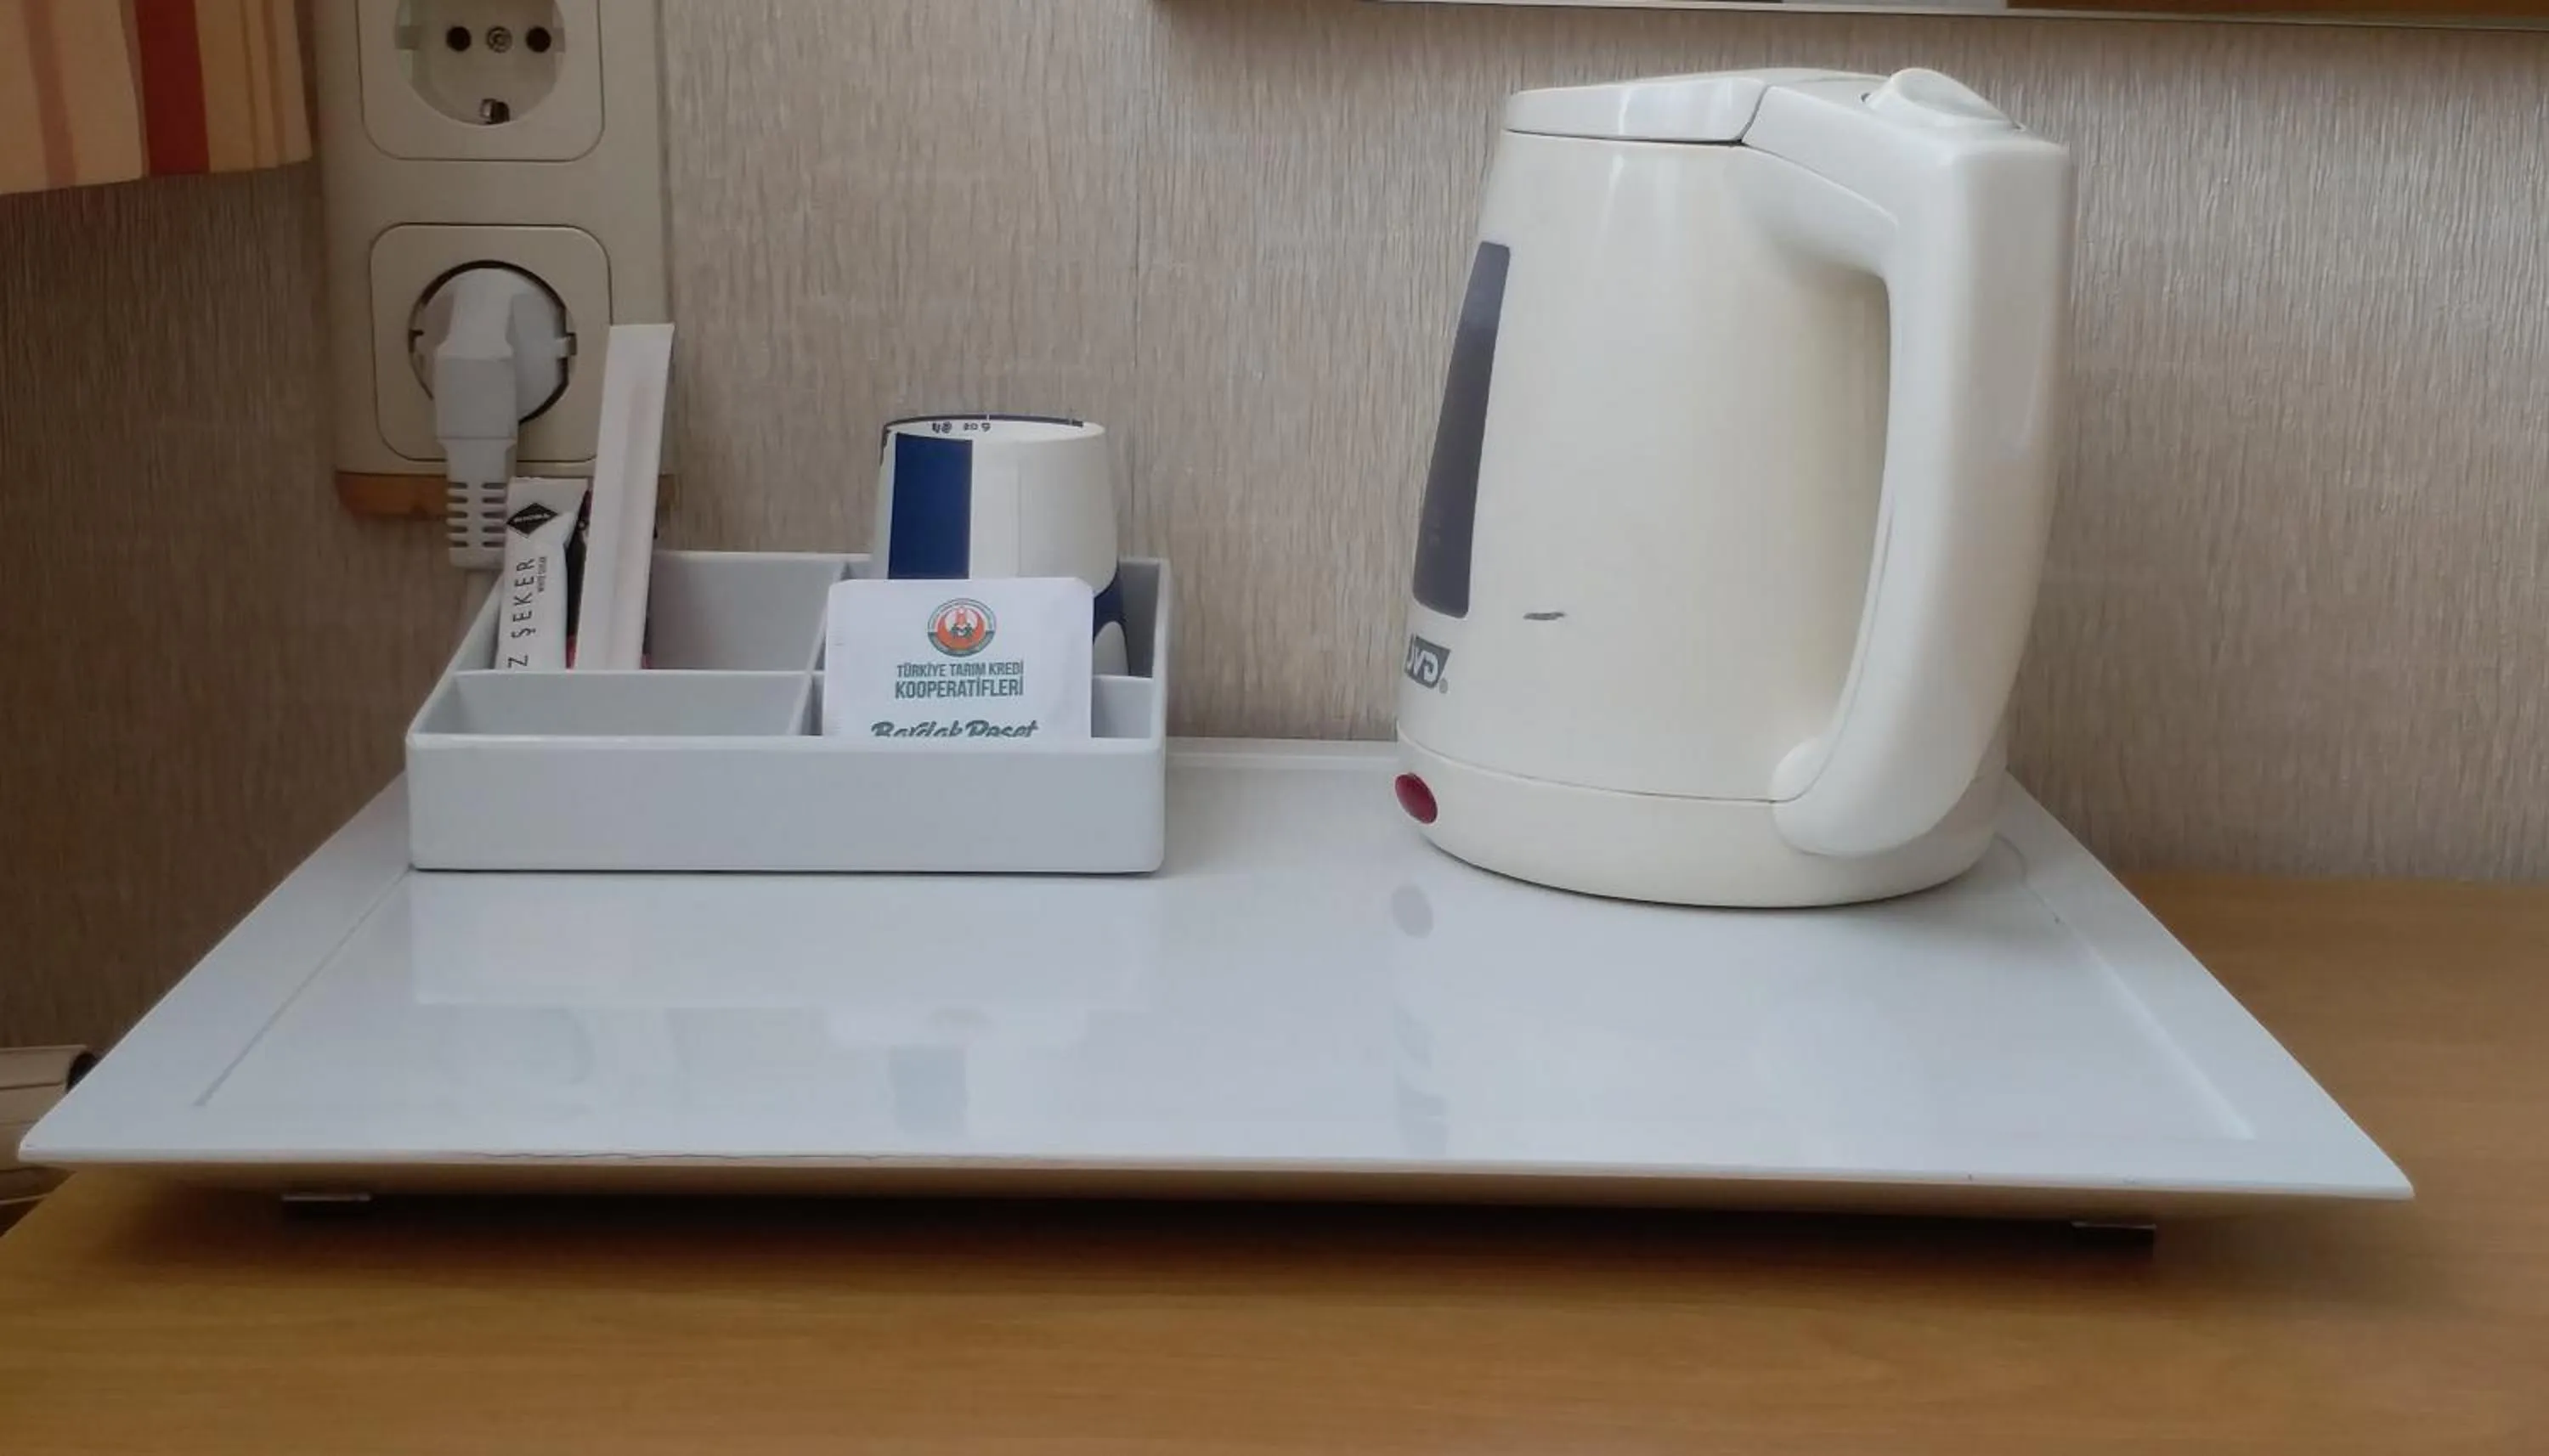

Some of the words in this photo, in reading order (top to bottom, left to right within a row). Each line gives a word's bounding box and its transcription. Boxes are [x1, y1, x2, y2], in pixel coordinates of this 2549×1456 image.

[511, 557, 536, 639] ŞEKER
[896, 663, 946, 679] TÜRKİYE
[948, 662, 986, 677] TARIM
[988, 660, 1024, 675] KREDİ
[895, 678, 1024, 700] KOOPERATİFLERİ
